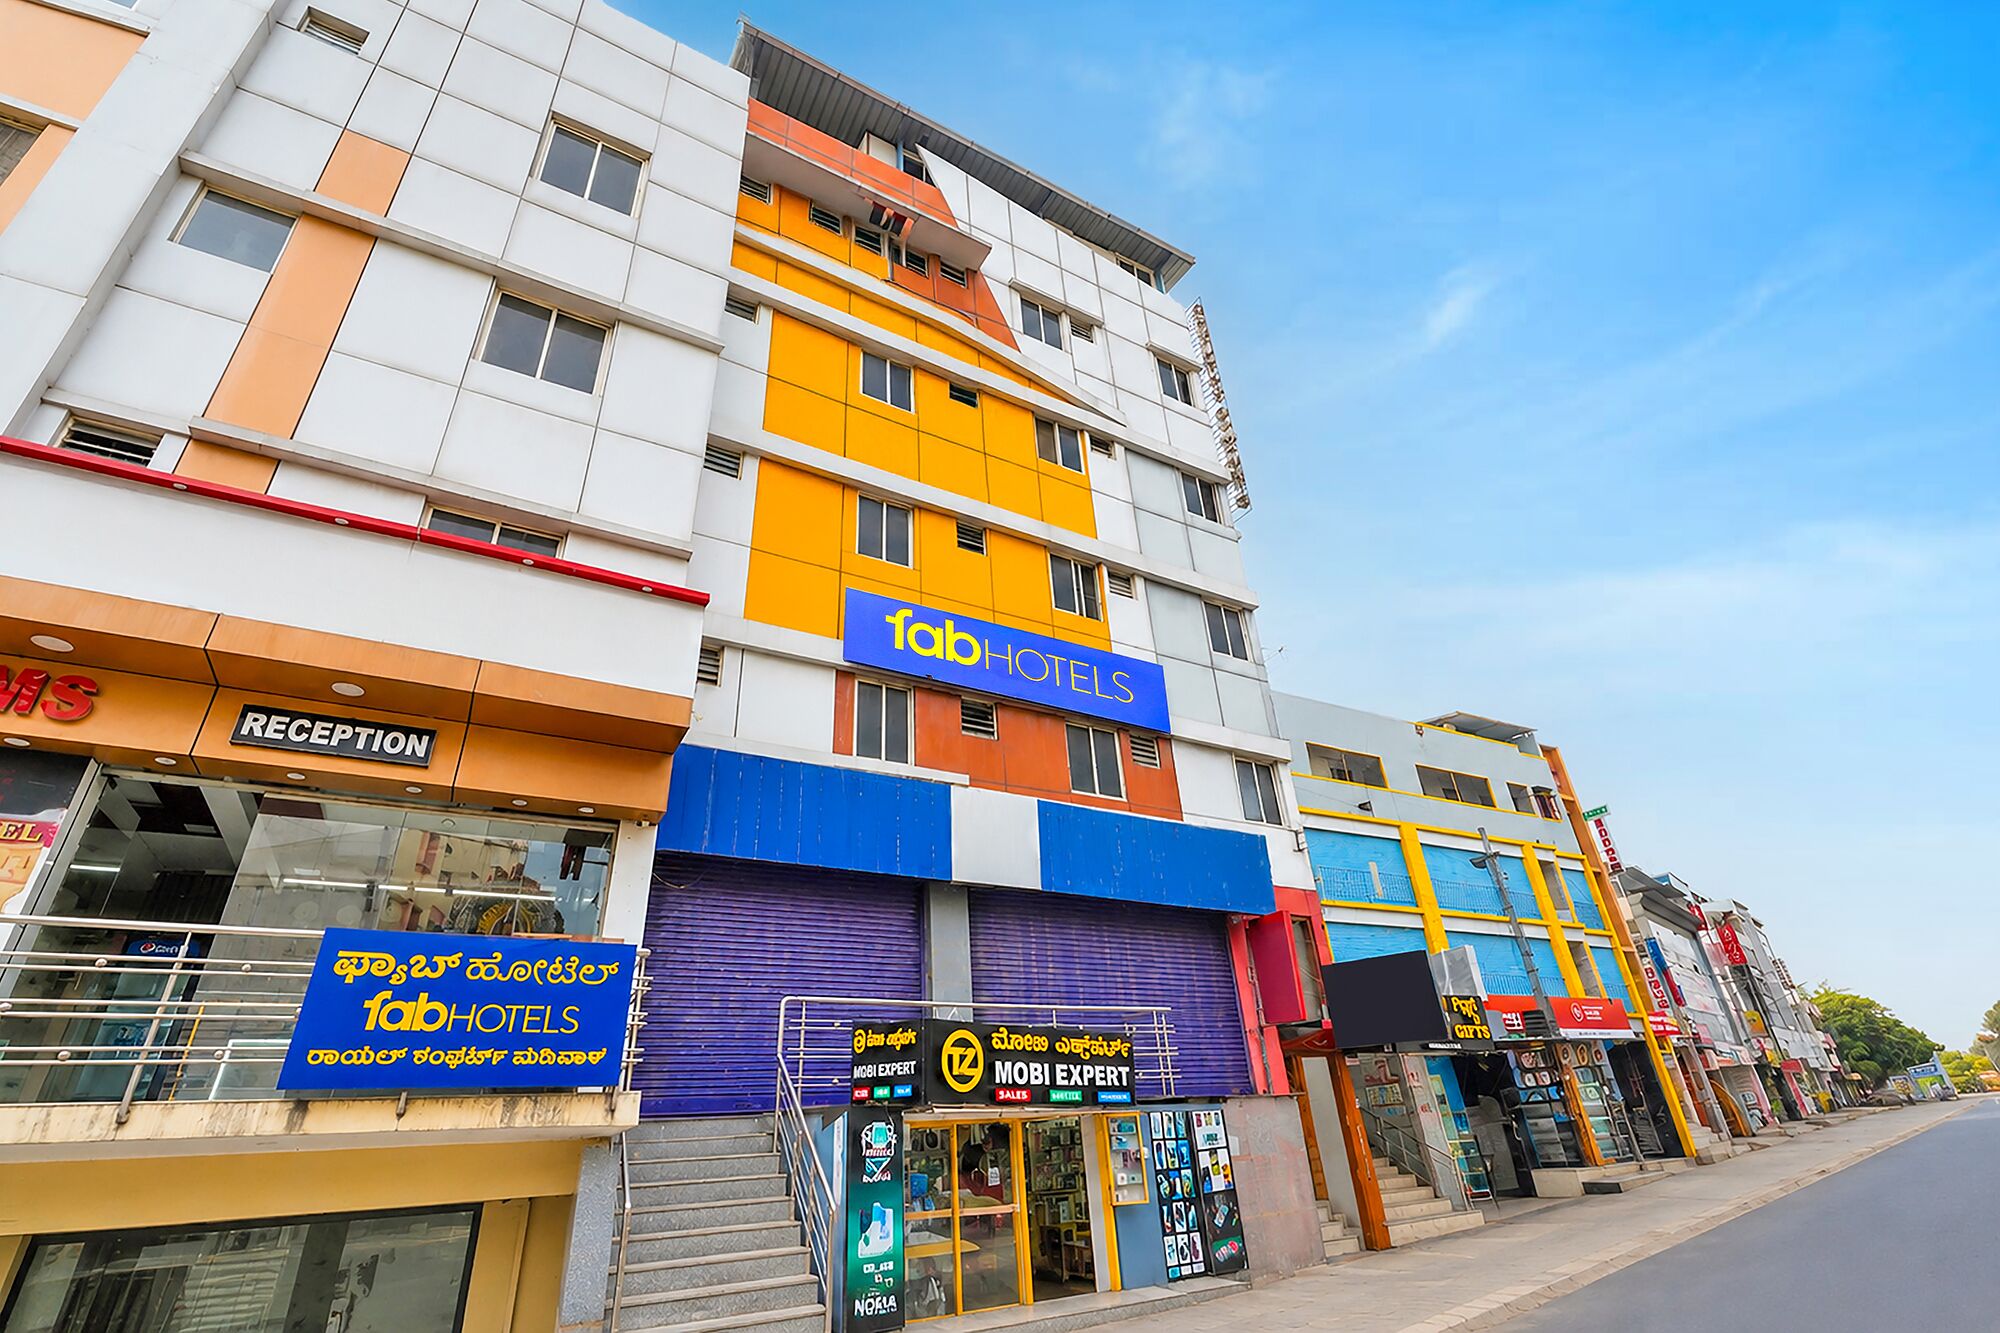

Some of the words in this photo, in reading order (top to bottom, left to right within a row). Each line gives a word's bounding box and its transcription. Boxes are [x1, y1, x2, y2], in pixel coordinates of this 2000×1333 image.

[239, 711, 430, 758] RECEPTION
[465, 951, 620, 985] ಹೋಟೆಲ್
[1454, 1024, 1491, 1039] GIFTS
[853, 1065, 877, 1079] MOBI
[878, 1060, 917, 1077] EXPERT
[995, 1060, 1050, 1086] MOBI
[1055, 1064, 1131, 1087] EXPERT
[998, 1090, 1029, 1100] SALES
